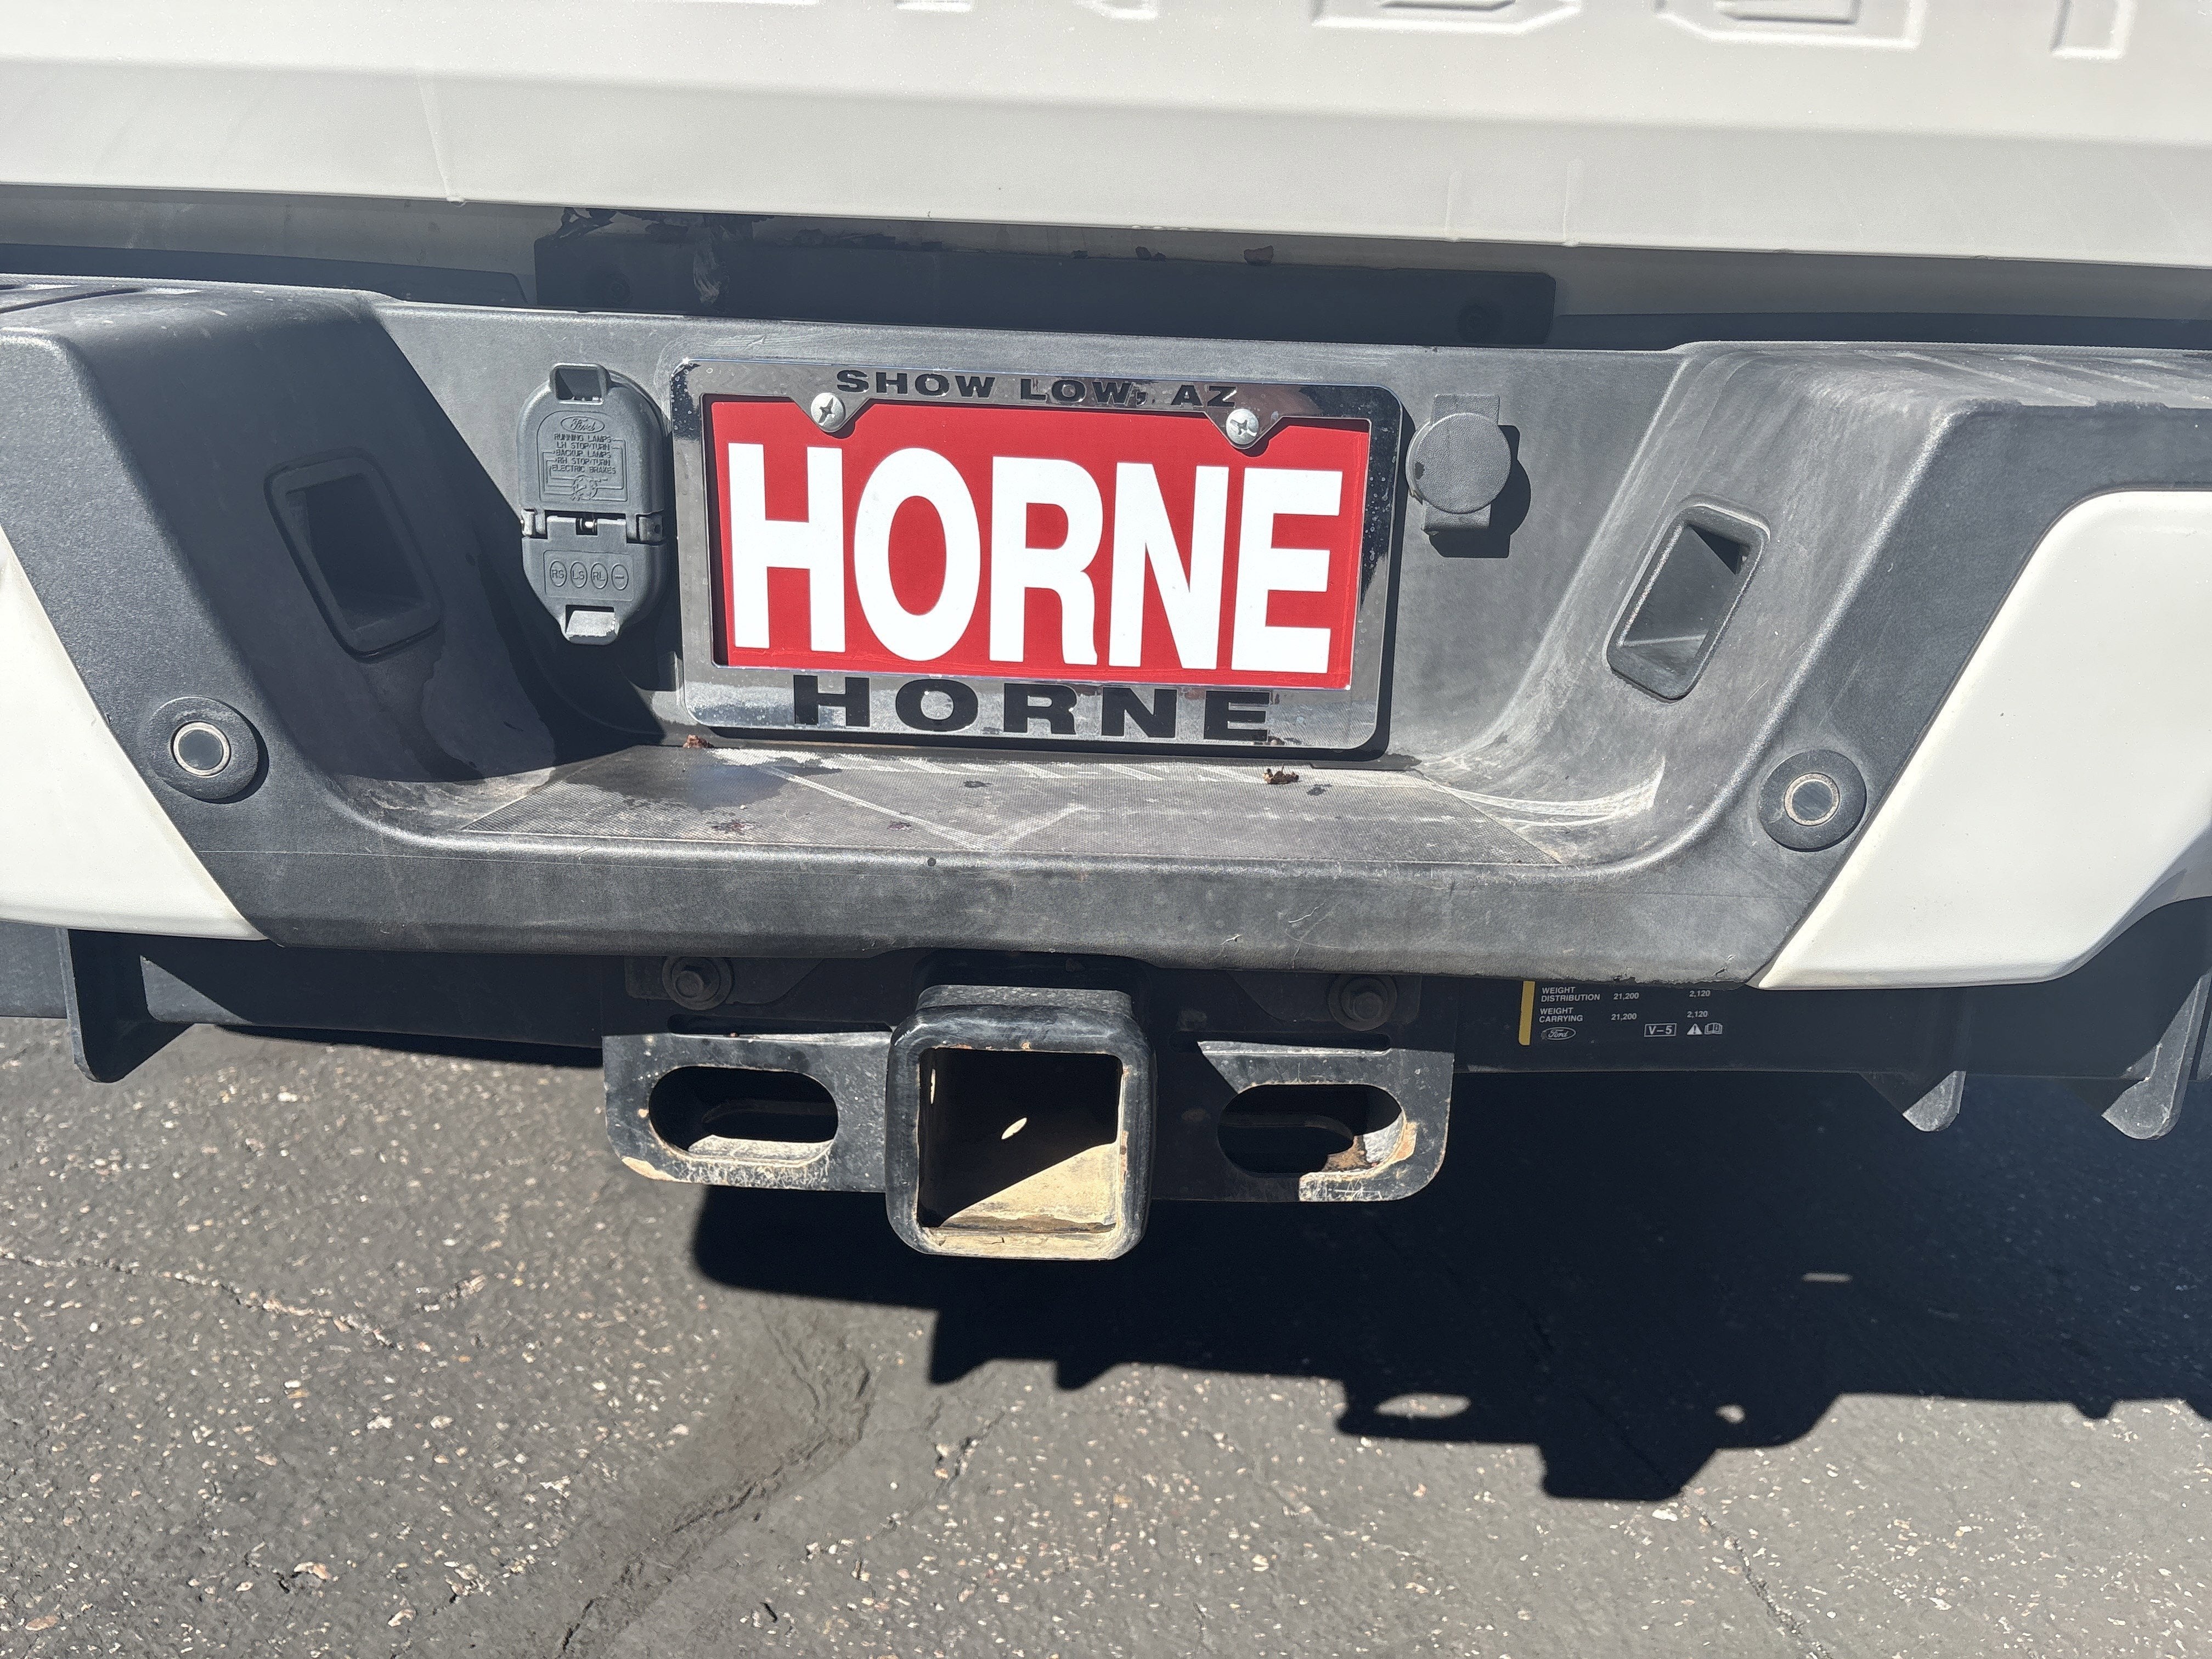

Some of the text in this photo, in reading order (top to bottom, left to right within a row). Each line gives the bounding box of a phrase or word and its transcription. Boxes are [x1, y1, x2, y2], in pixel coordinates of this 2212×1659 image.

[837, 369, 995, 398] SHOW
[1170, 384, 1238, 408] AZ
[571, 418, 596, 432] Ford
[554, 433, 584, 442] RUNNING
[571, 442, 610, 450] STOP/TURN
[556, 449, 583, 457] BACKUP
[571, 458, 611, 466] STOP/TURN
[552, 465, 616, 474] ELECTRIC BRAKES
[728, 442, 1343, 674] HORNE
[551, 569, 606, 581] RS LS RL
[793, 674, 1272, 741] HORNE
[1541, 993, 1600, 1002] DISTRIBUTION
[1613, 992, 1639, 1000] 21,200
[1689, 990, 1711, 998] 2,120
[1539, 1014, 1583, 1023] CARRYING
[1611, 1013, 1638, 1021] 21,200
[1686, 1011, 1709, 1019] 2,120
[1548, 1029, 1568, 1039] Ford
[1648, 1025, 1673, 1035] V-5
